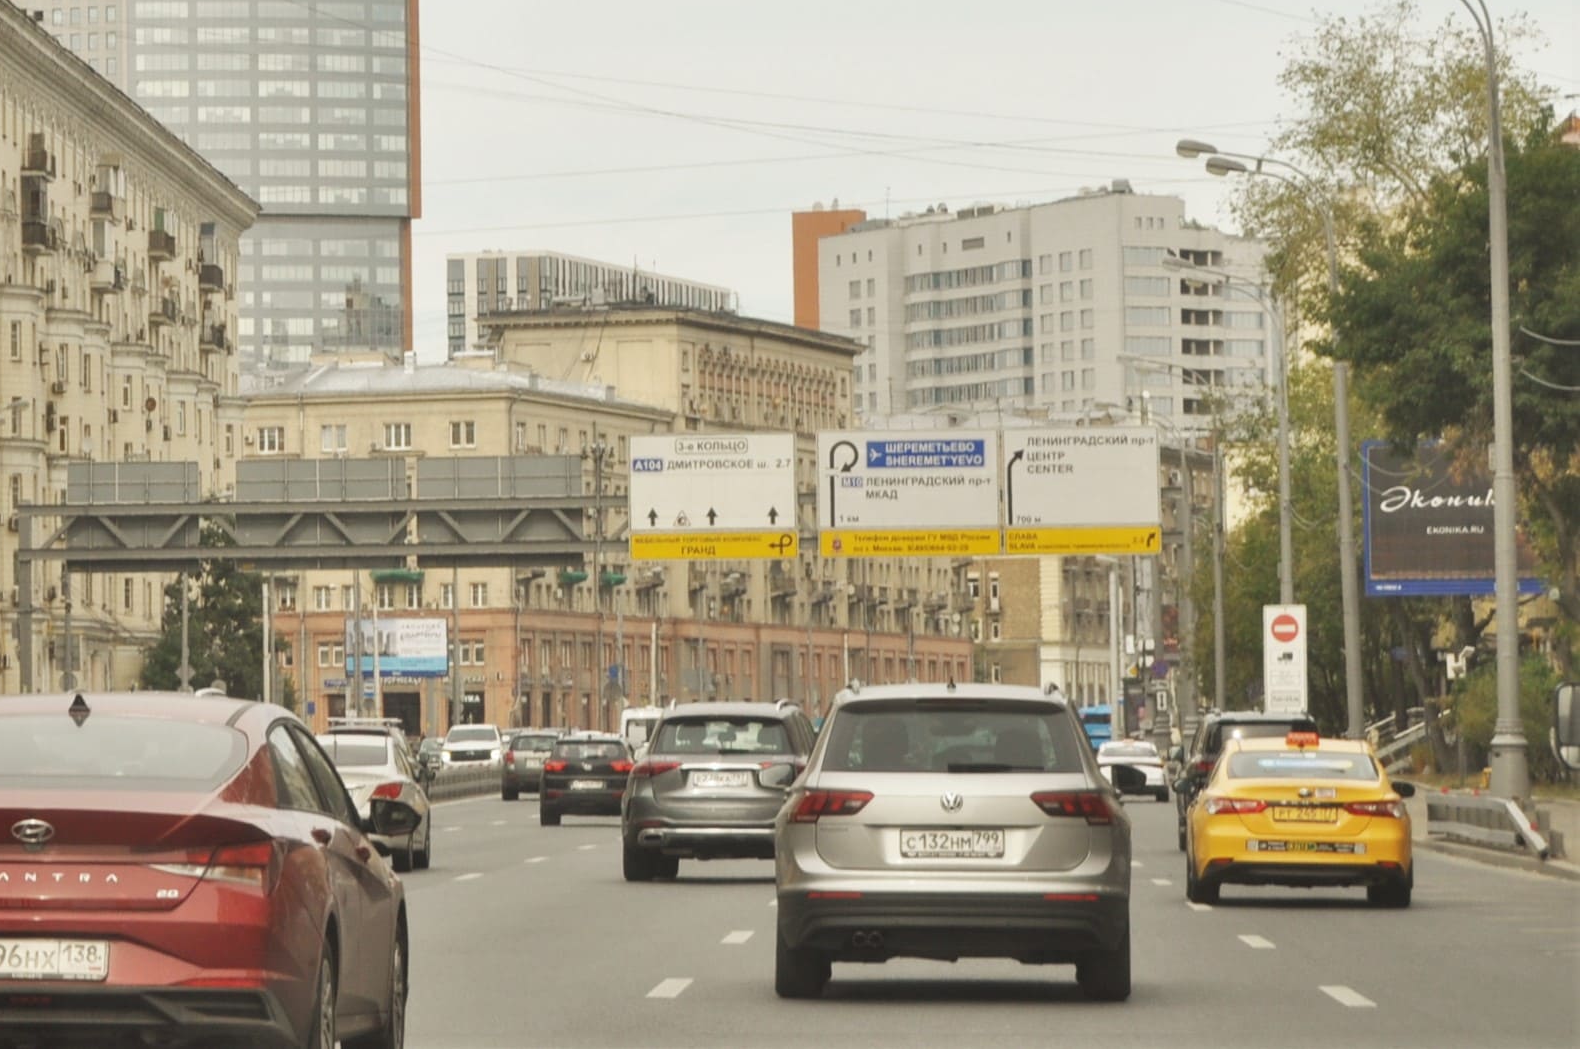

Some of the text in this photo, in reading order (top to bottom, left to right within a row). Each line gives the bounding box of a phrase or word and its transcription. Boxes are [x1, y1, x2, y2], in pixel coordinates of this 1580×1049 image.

[697, 440, 746, 453] КОЛЬЦО
[885, 441, 976, 453] ШЕРЕМЕТЬЕВО
[1027, 436, 1128, 447] ЛЕНИНГРАДСКИЙ
[885, 454, 983, 466] SHEREMET'YEVO
[1027, 451, 1065, 462] ЦЕНТР
[634, 459, 662, 471] А104
[666, 458, 753, 471] ДМИТРОВСКОЕ
[776, 458, 792, 469] 2.7
[1027, 464, 1074, 474] CENTER
[865, 475, 965, 488] ЛЕНИНГРАДСКИЙ
[967, 477, 991, 488] пр-т
[865, 489, 898, 500] МКАД
[1380, 485, 1497, 513] Экони
[1426, 526, 1485, 535] EKONIKA.RU
[681, 545, 717, 556] ГРАНД
[906, 832, 999, 850] С132НМ 799
[62, 944, 98, 963] 138
